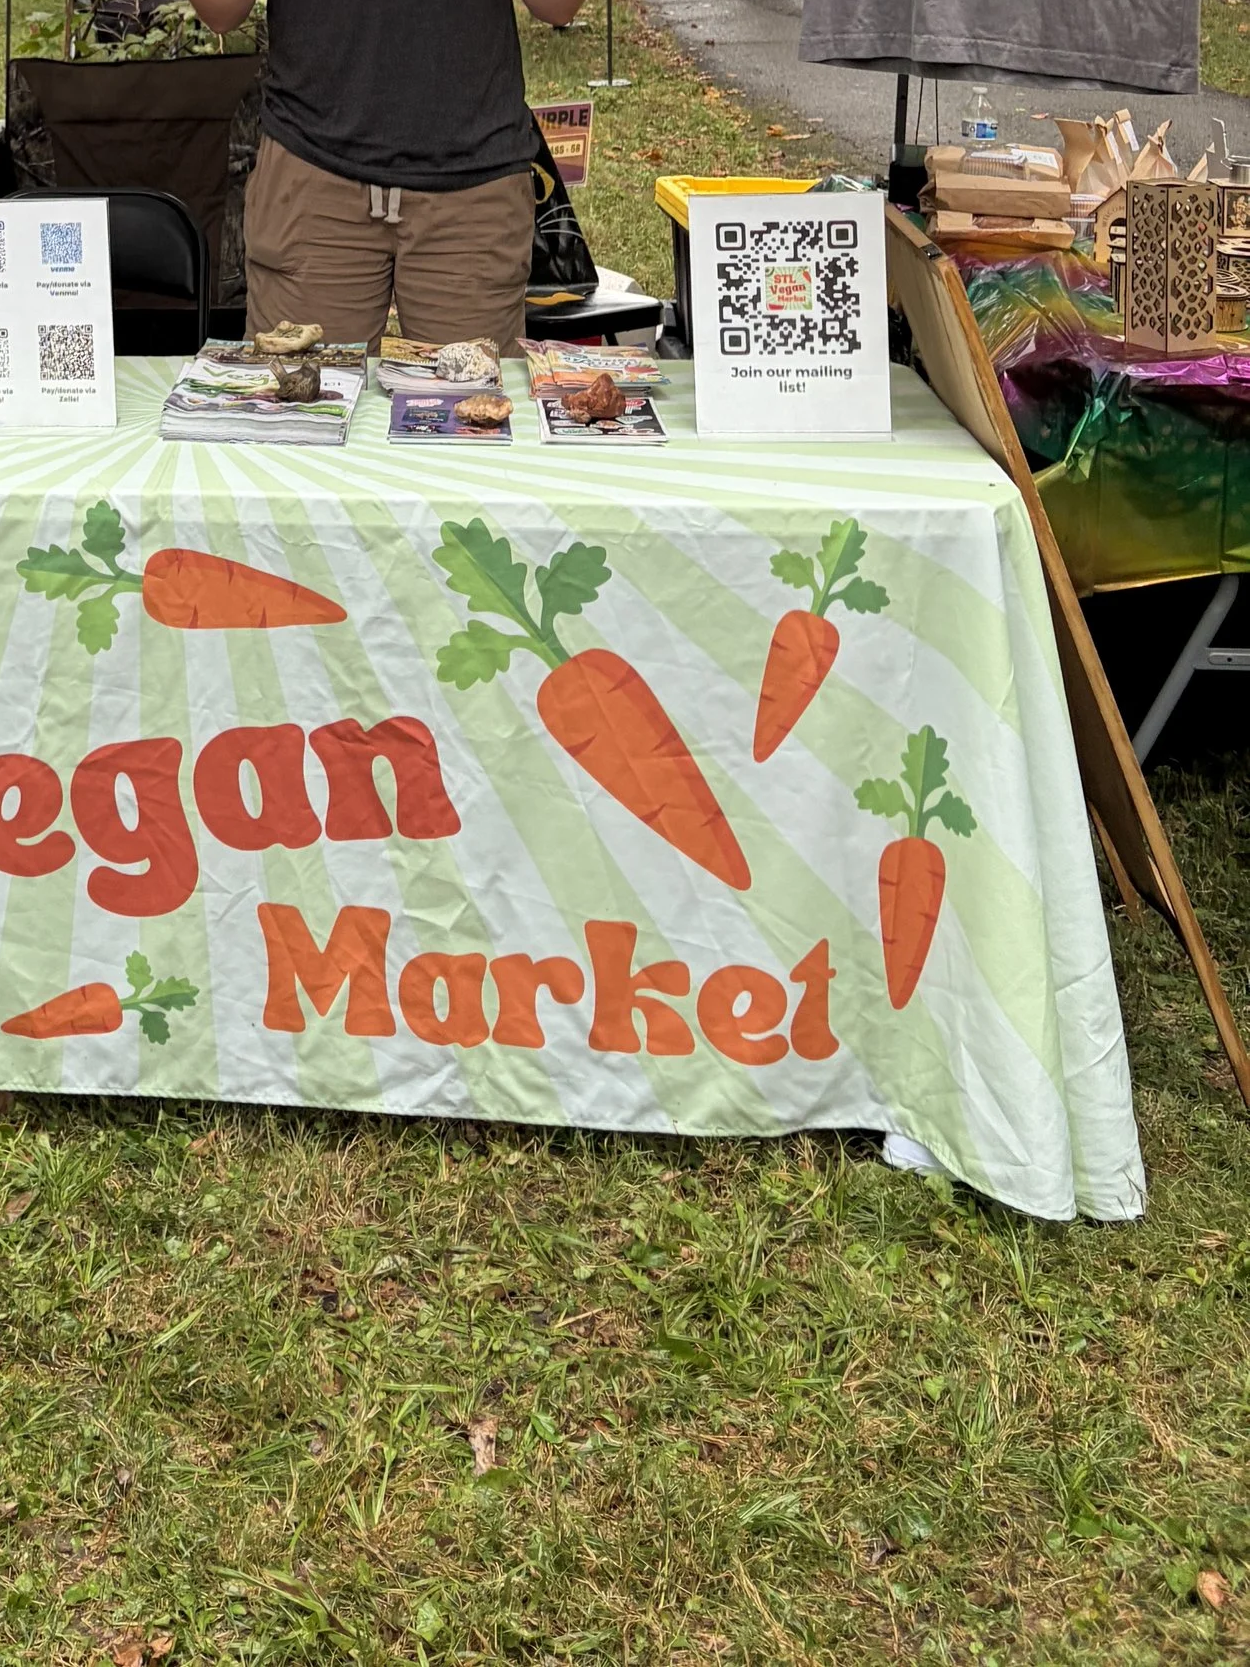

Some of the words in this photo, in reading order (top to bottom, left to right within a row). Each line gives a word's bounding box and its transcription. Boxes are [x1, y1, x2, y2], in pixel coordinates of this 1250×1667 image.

[774, 274, 796, 284] STL
[769, 284, 806, 296] Vegan
[731, 366, 762, 378] Join
[766, 368, 792, 378] our
[795, 365, 853, 380] mailing
[2, 387, 14, 395] via
[85, 386, 96, 394] via
[779, 381, 806, 393] list!
[259, 904, 843, 1067] Market
